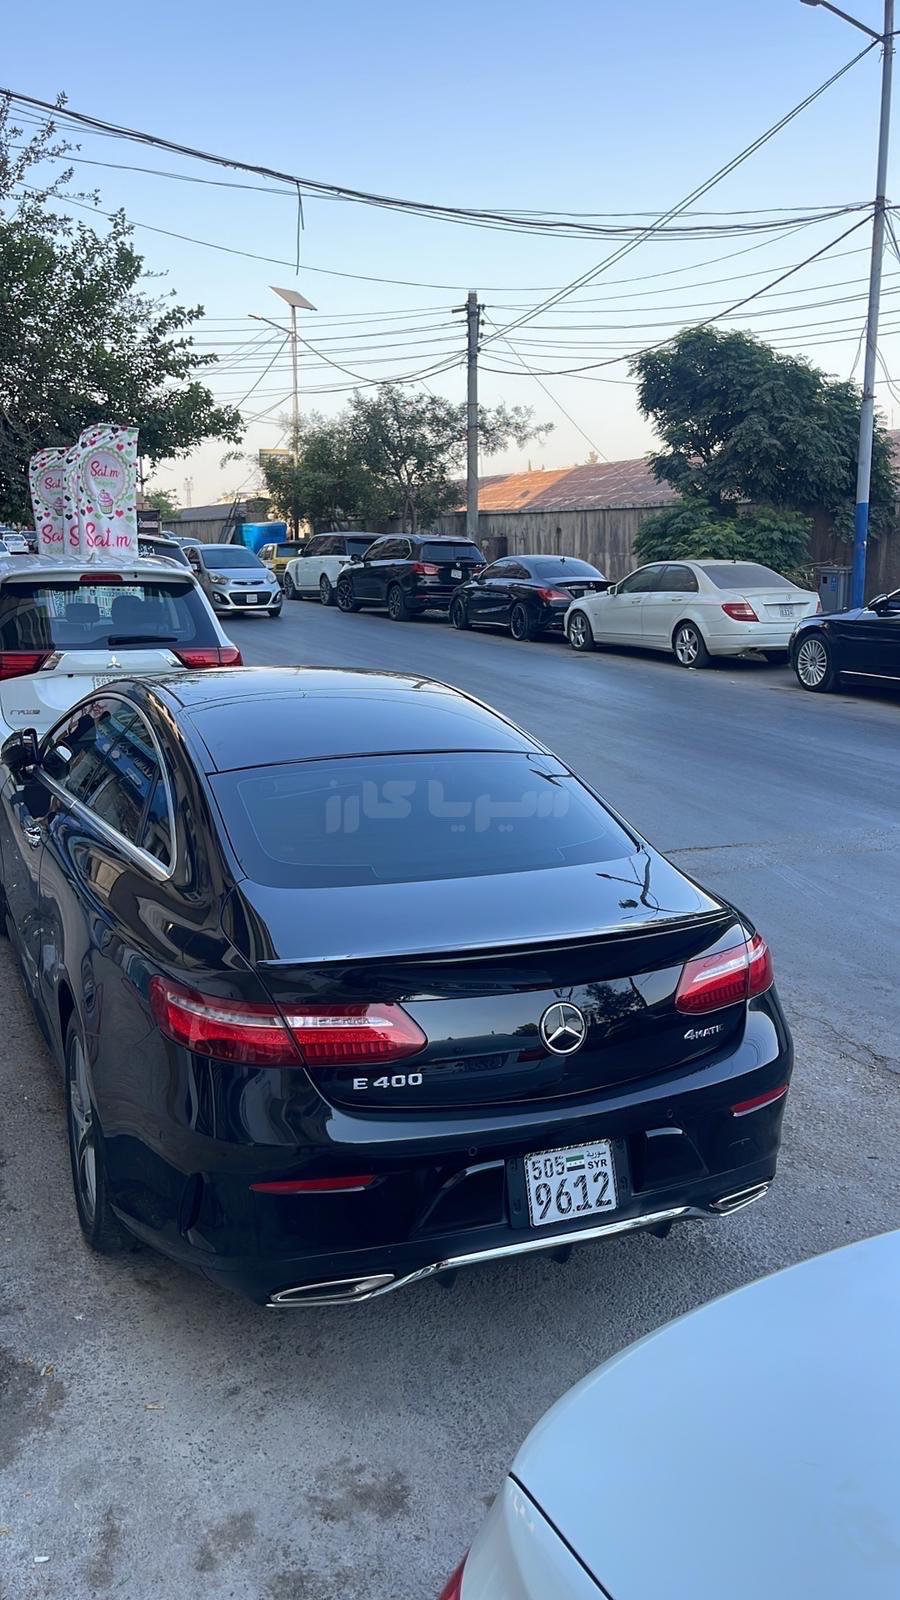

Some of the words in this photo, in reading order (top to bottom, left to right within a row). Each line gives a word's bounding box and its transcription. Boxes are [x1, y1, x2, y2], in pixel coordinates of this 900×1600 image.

[683, 1024, 724, 1040] 4MATIC
[352, 1077, 369, 1090] E
[372, 1073, 423, 1089] 400
[531, 1155, 565, 1181] 505
[587, 1158, 608, 1170] SYR
[535, 1170, 613, 1220] 9612
